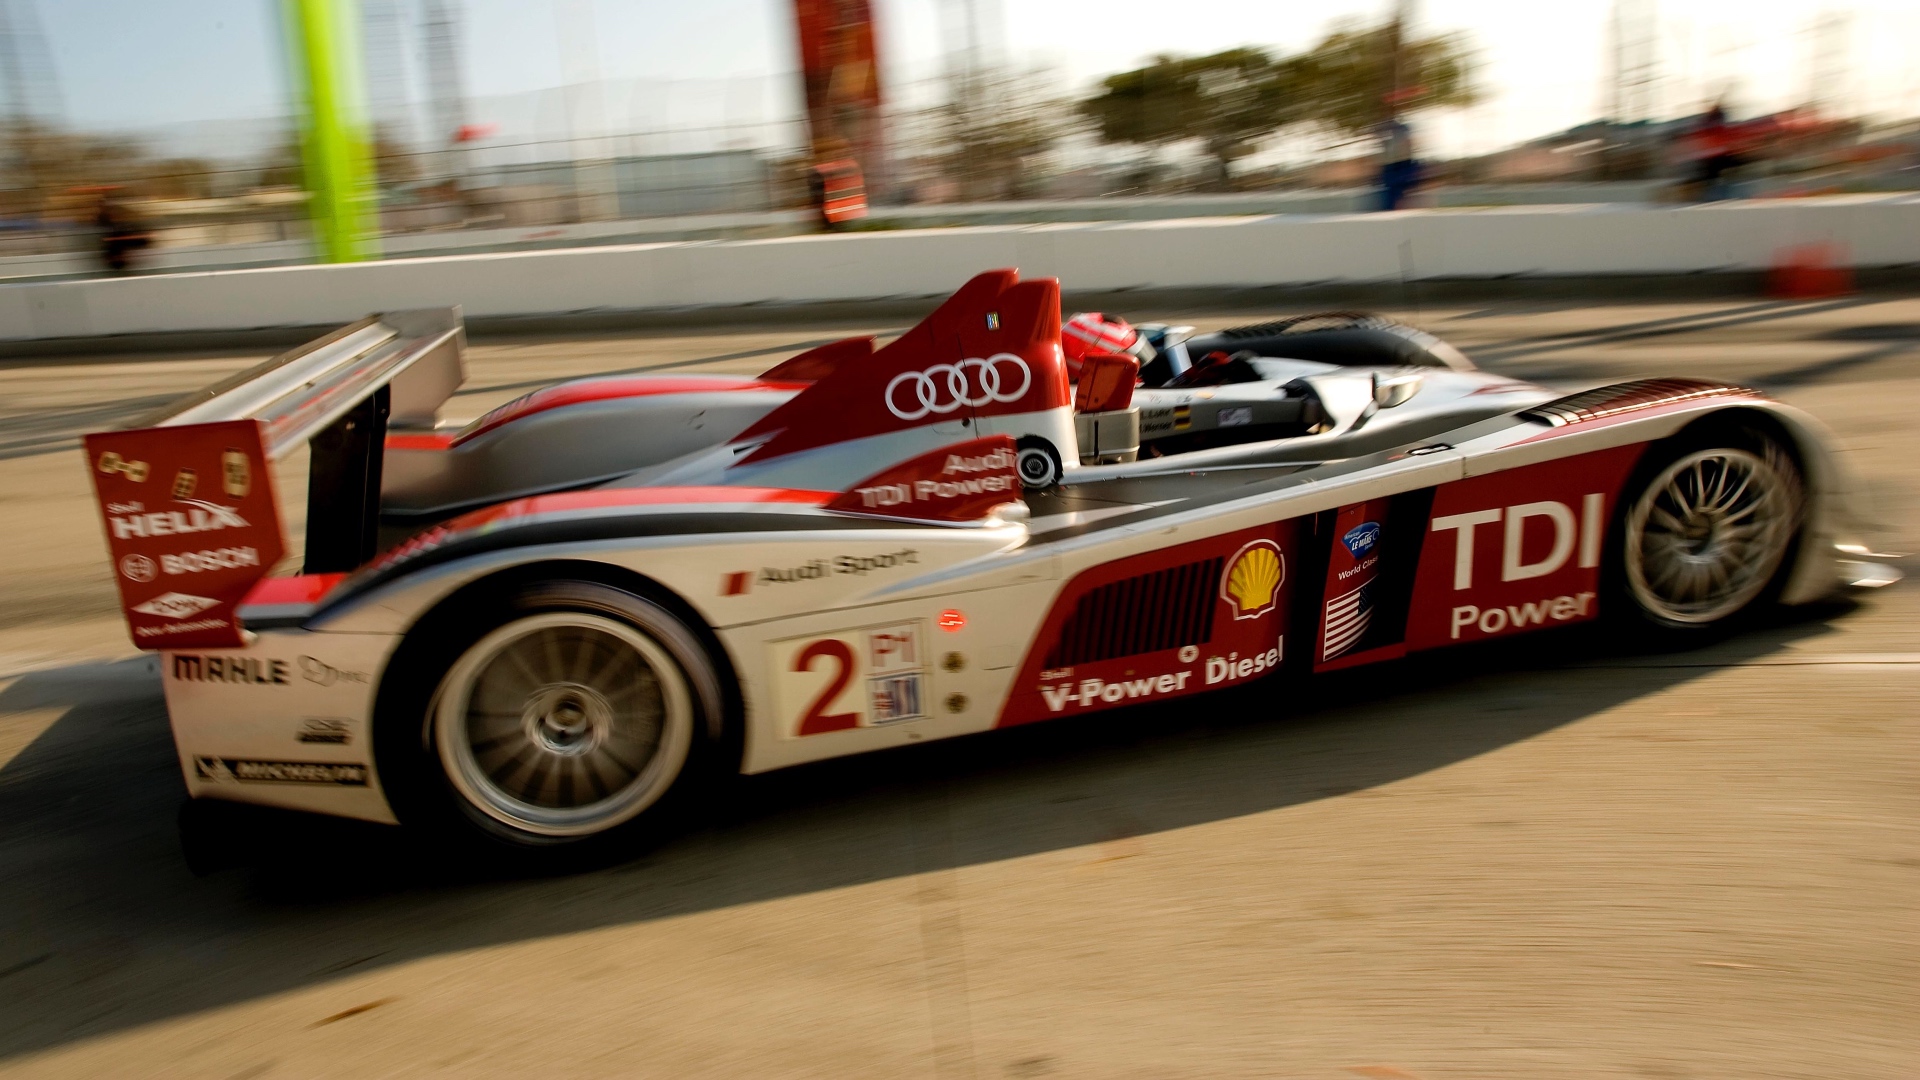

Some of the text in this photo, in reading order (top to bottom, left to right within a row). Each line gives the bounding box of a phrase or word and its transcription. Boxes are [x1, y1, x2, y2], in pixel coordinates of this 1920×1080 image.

[942, 447, 1016, 476] Audi
[855, 474, 1015, 508] TDI Power
[109, 504, 252, 540] HELIX
[1431, 492, 1606, 590] TDI
[159, 545, 261, 575] BOSCH
[756, 548, 920, 587] Audi Sport
[1338, 564, 1361, 581] World
[1451, 591, 1597, 639] Power
[173, 652, 292, 687] MAHLE
[788, 638, 863, 738] 2
[869, 631, 916, 668] P1
[1040, 634, 1284, 712] V-Power Diesel
